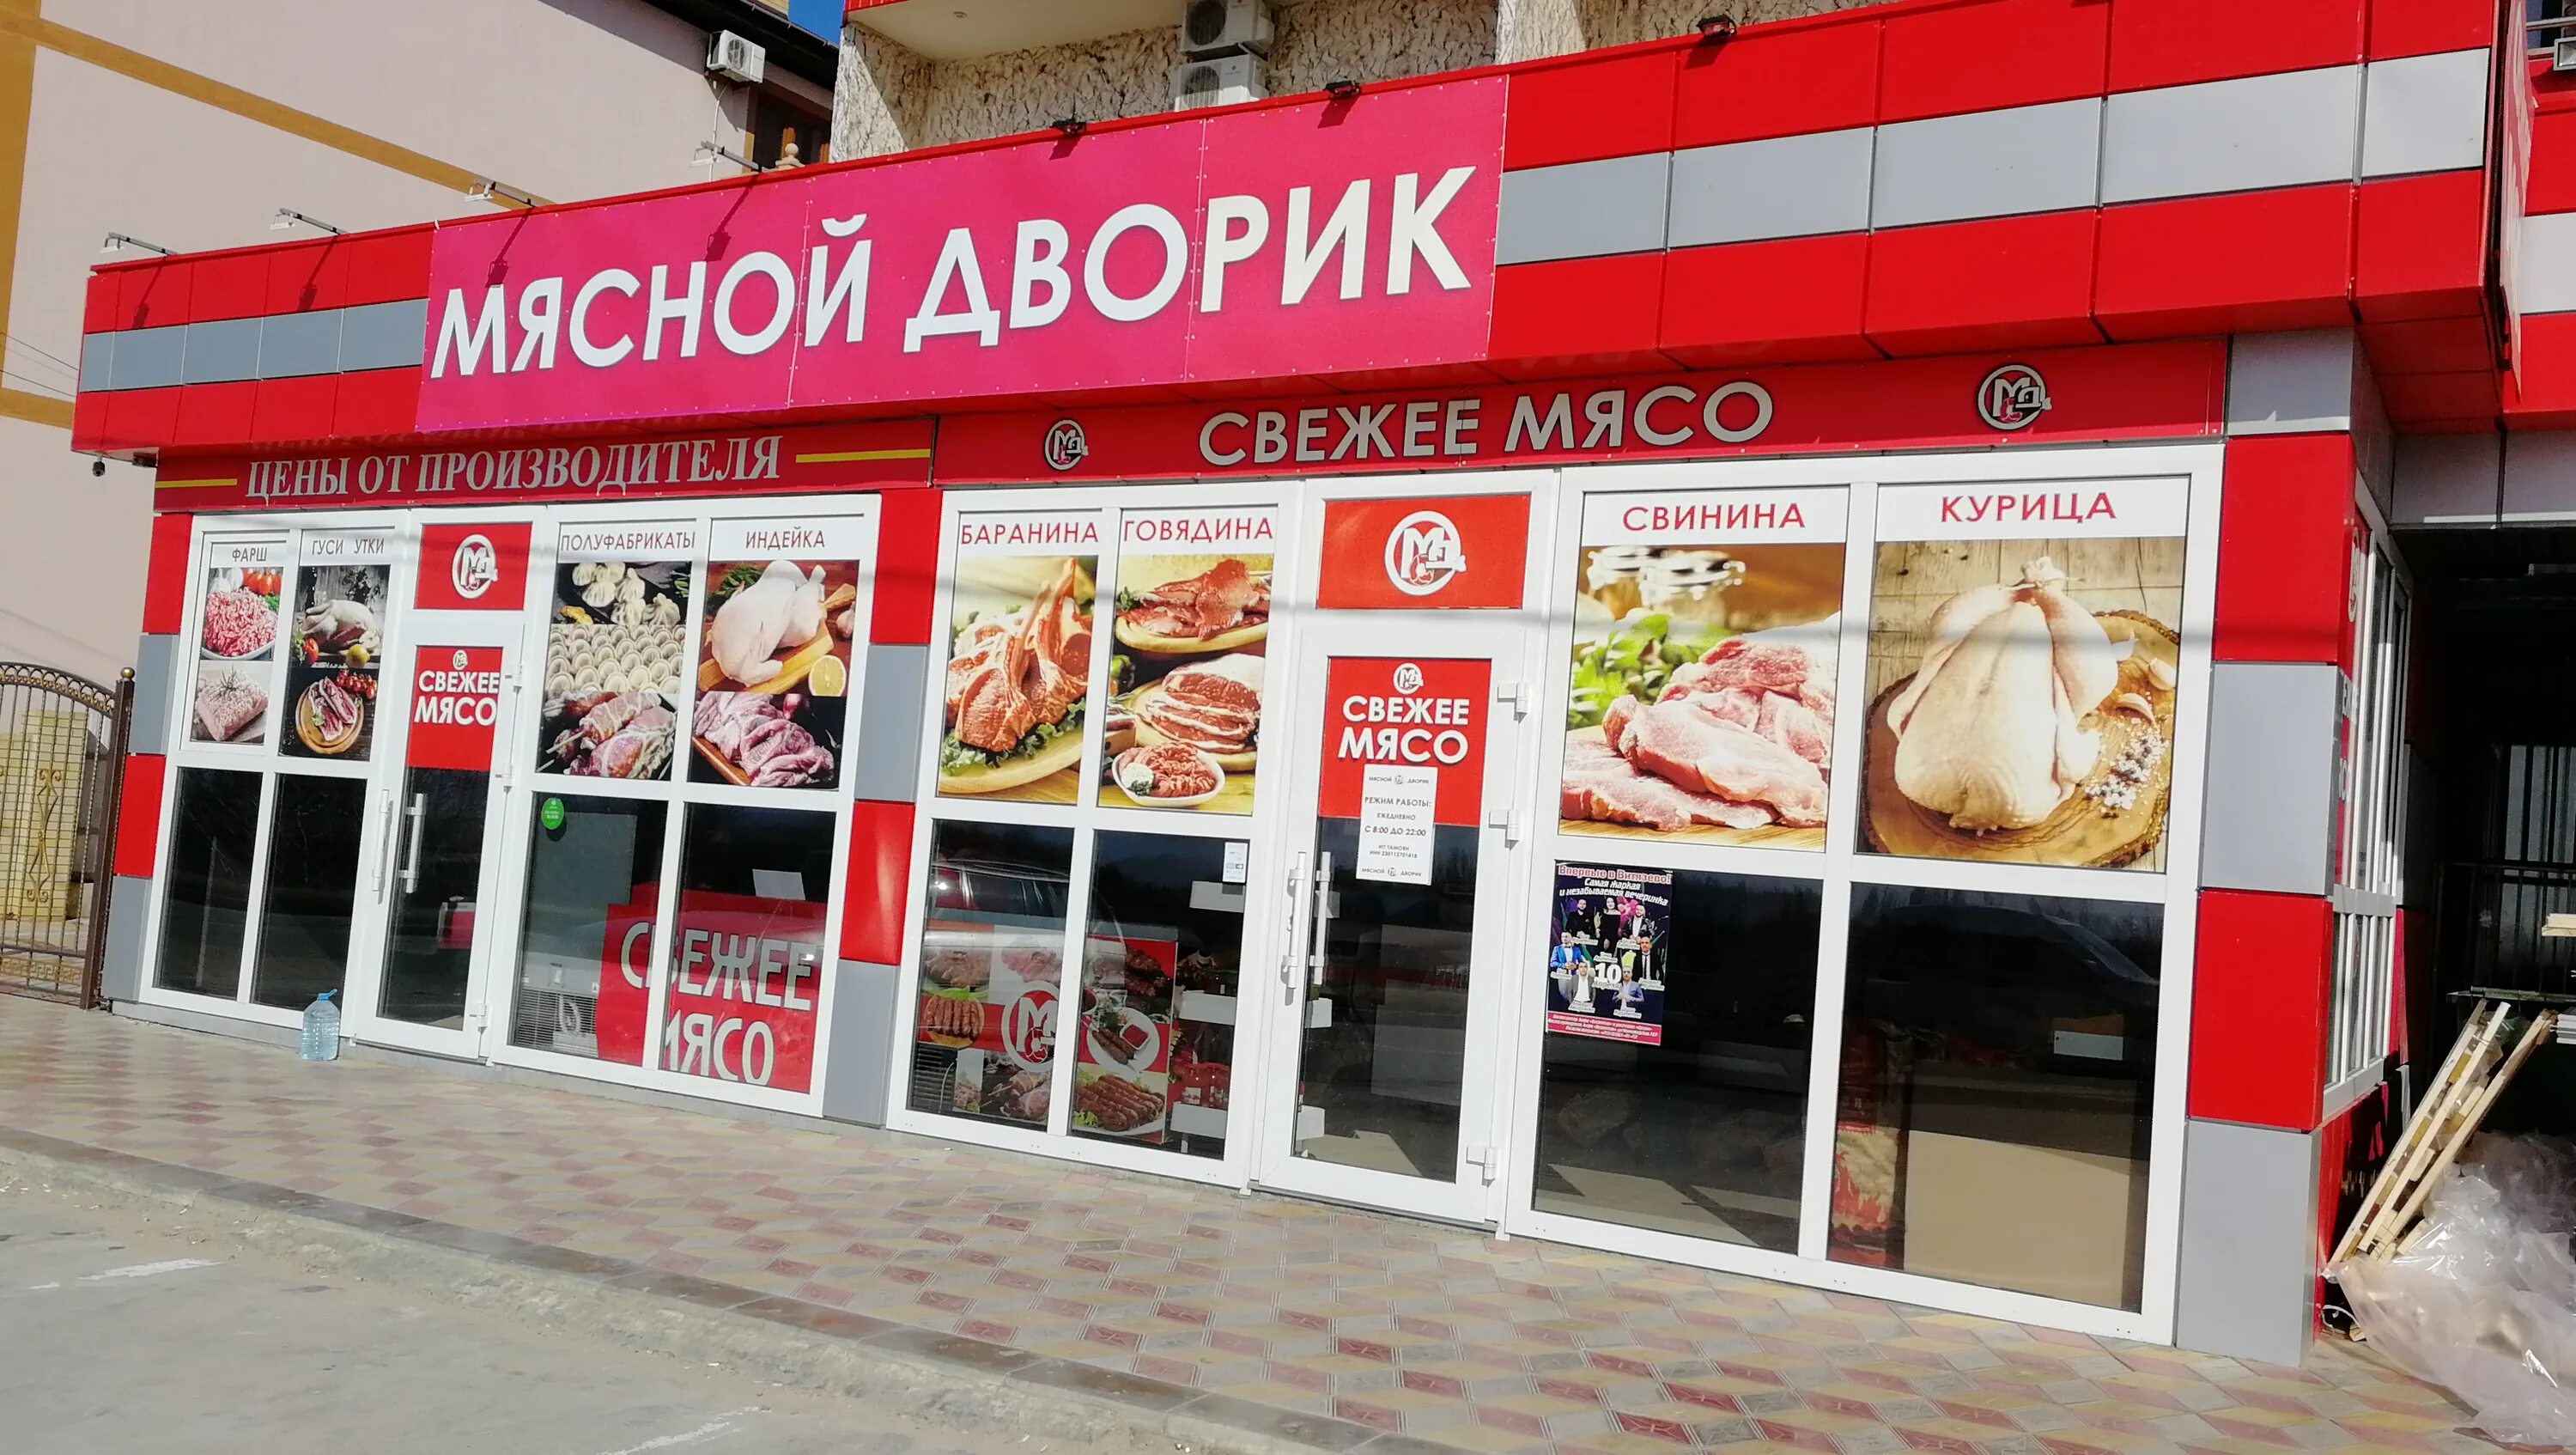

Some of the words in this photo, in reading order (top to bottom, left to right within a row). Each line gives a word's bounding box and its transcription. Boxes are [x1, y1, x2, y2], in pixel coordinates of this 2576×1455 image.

[430, 213, 872, 379] МЯСНОЙ
[902, 165, 1478, 353] ДВОРИК
[1199, 399, 1481, 466] СВЕЖЕЕ
[1504, 381, 1774, 453] МЯСО
[245, 459, 349, 505] ЦЕНЫ
[358, 454, 409, 495] ОТ
[414, 435, 783, 496] ПРОИЗВОДИТЕЛЯ
[1622, 503, 1806, 532] СВИНИНА
[1940, 491, 2117, 525] КУРИЦА
[561, 532, 695, 551] ПОЛУФАБРИКАТЫ
[745, 526, 825, 551] ИНДЕЙКА
[961, 522, 1098, 545] БАРАНИНА
[1123, 516, 1273, 544] ГОВЯДИНА
[231, 546, 267, 564] ФАРШ
[312, 539, 343, 557] ГУСИ
[354, 537, 385, 556] УТКИ
[417, 670, 499, 694] СВЕЖЕЕ
[414, 697, 497, 727] МЯСО
[1342, 695, 1470, 725] СВЕЖЕЕ
[1337, 727, 1468, 764] МЯСО
[1364, 796, 1394, 805] РЕЖИМ
[1395, 798, 1431, 807] РАБОТЫ:
[1372, 825, 1388, 834] 8:00
[1405, 828, 1426, 837] 22:00
[1558, 865, 1607, 878] Впервые
[1607, 870, 1615, 879] в
[1616, 869, 1672, 884] Витязево!
[1584, 878, 1608, 887] Самая
[1566, 886, 1624, 896] незабываемая
[1625, 891, 1668, 906] вечеринка
[1595, 962, 1622, 985] 10
